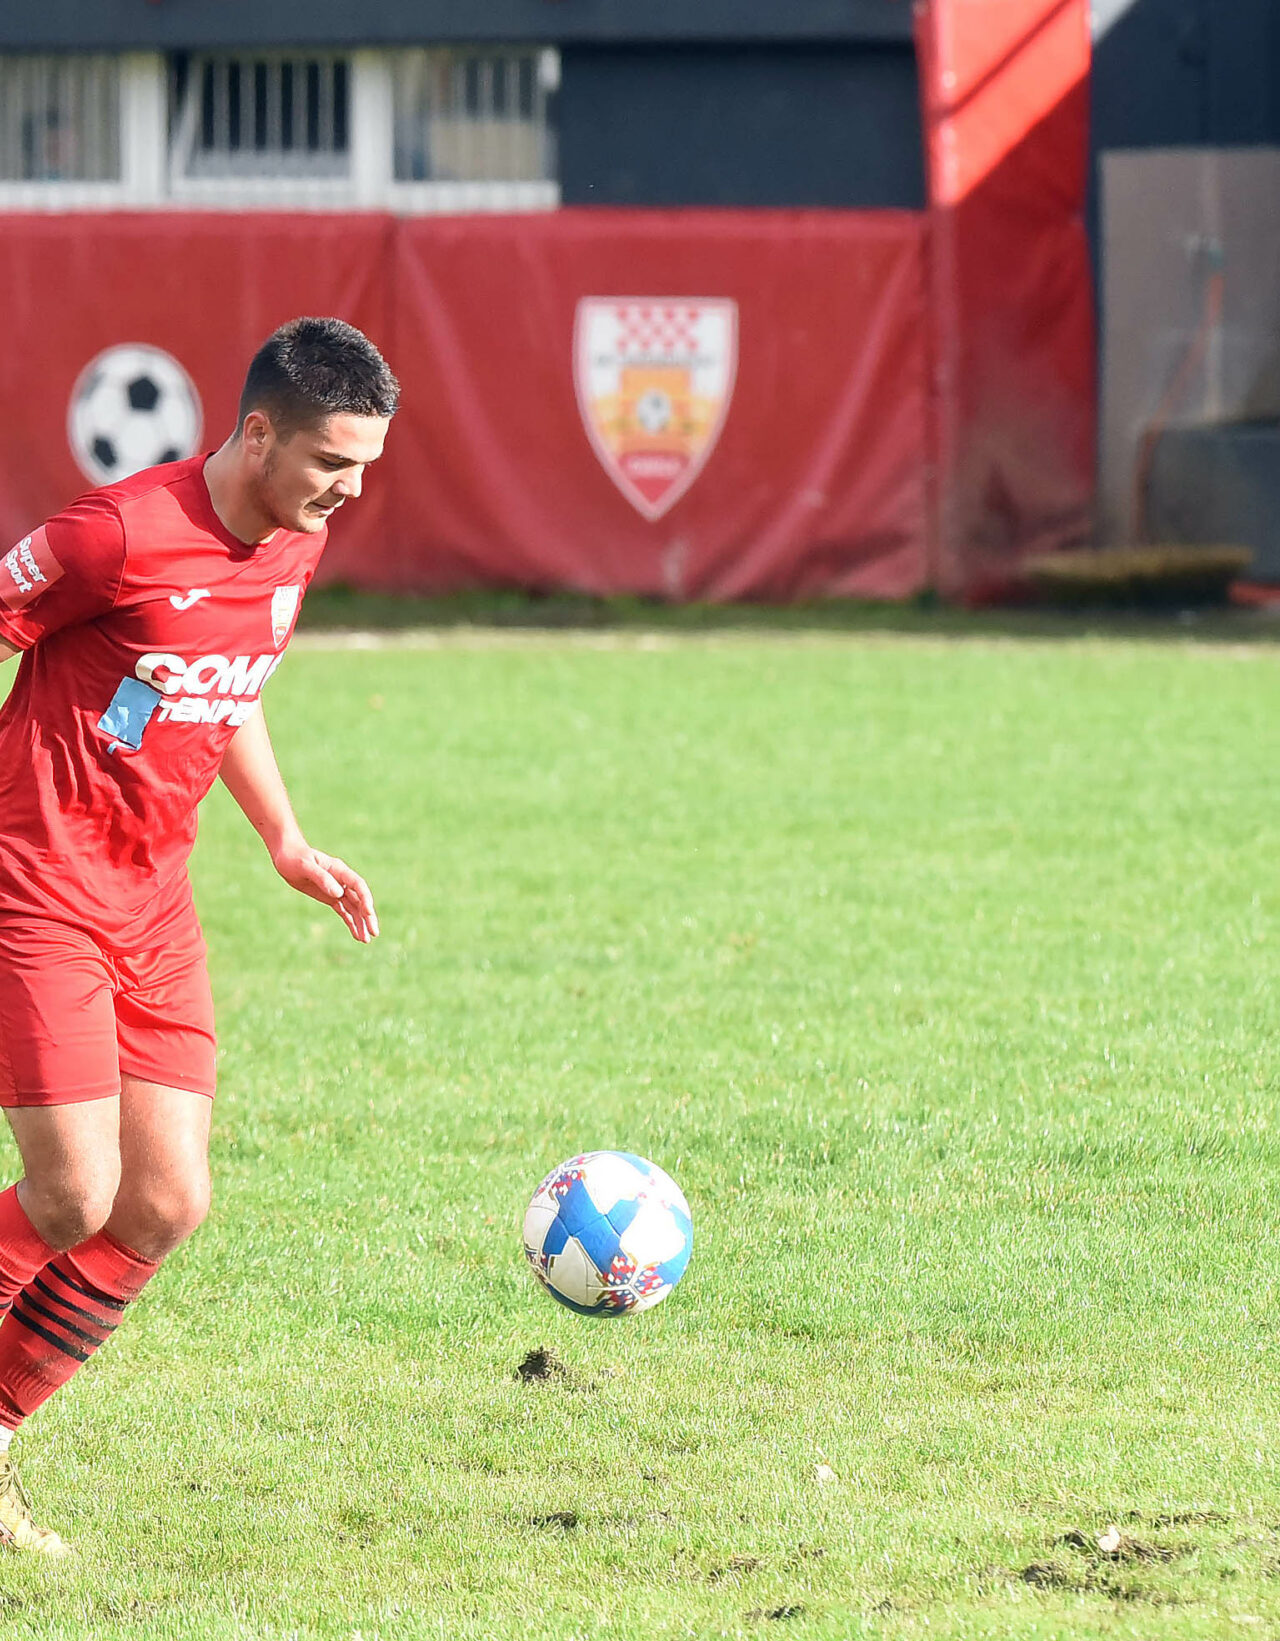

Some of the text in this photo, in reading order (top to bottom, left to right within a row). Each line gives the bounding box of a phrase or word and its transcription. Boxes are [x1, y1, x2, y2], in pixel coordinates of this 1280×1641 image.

[4, 549, 33, 593] Sport
[20, 536, 47, 582] Super
[135, 652, 284, 696] COM
